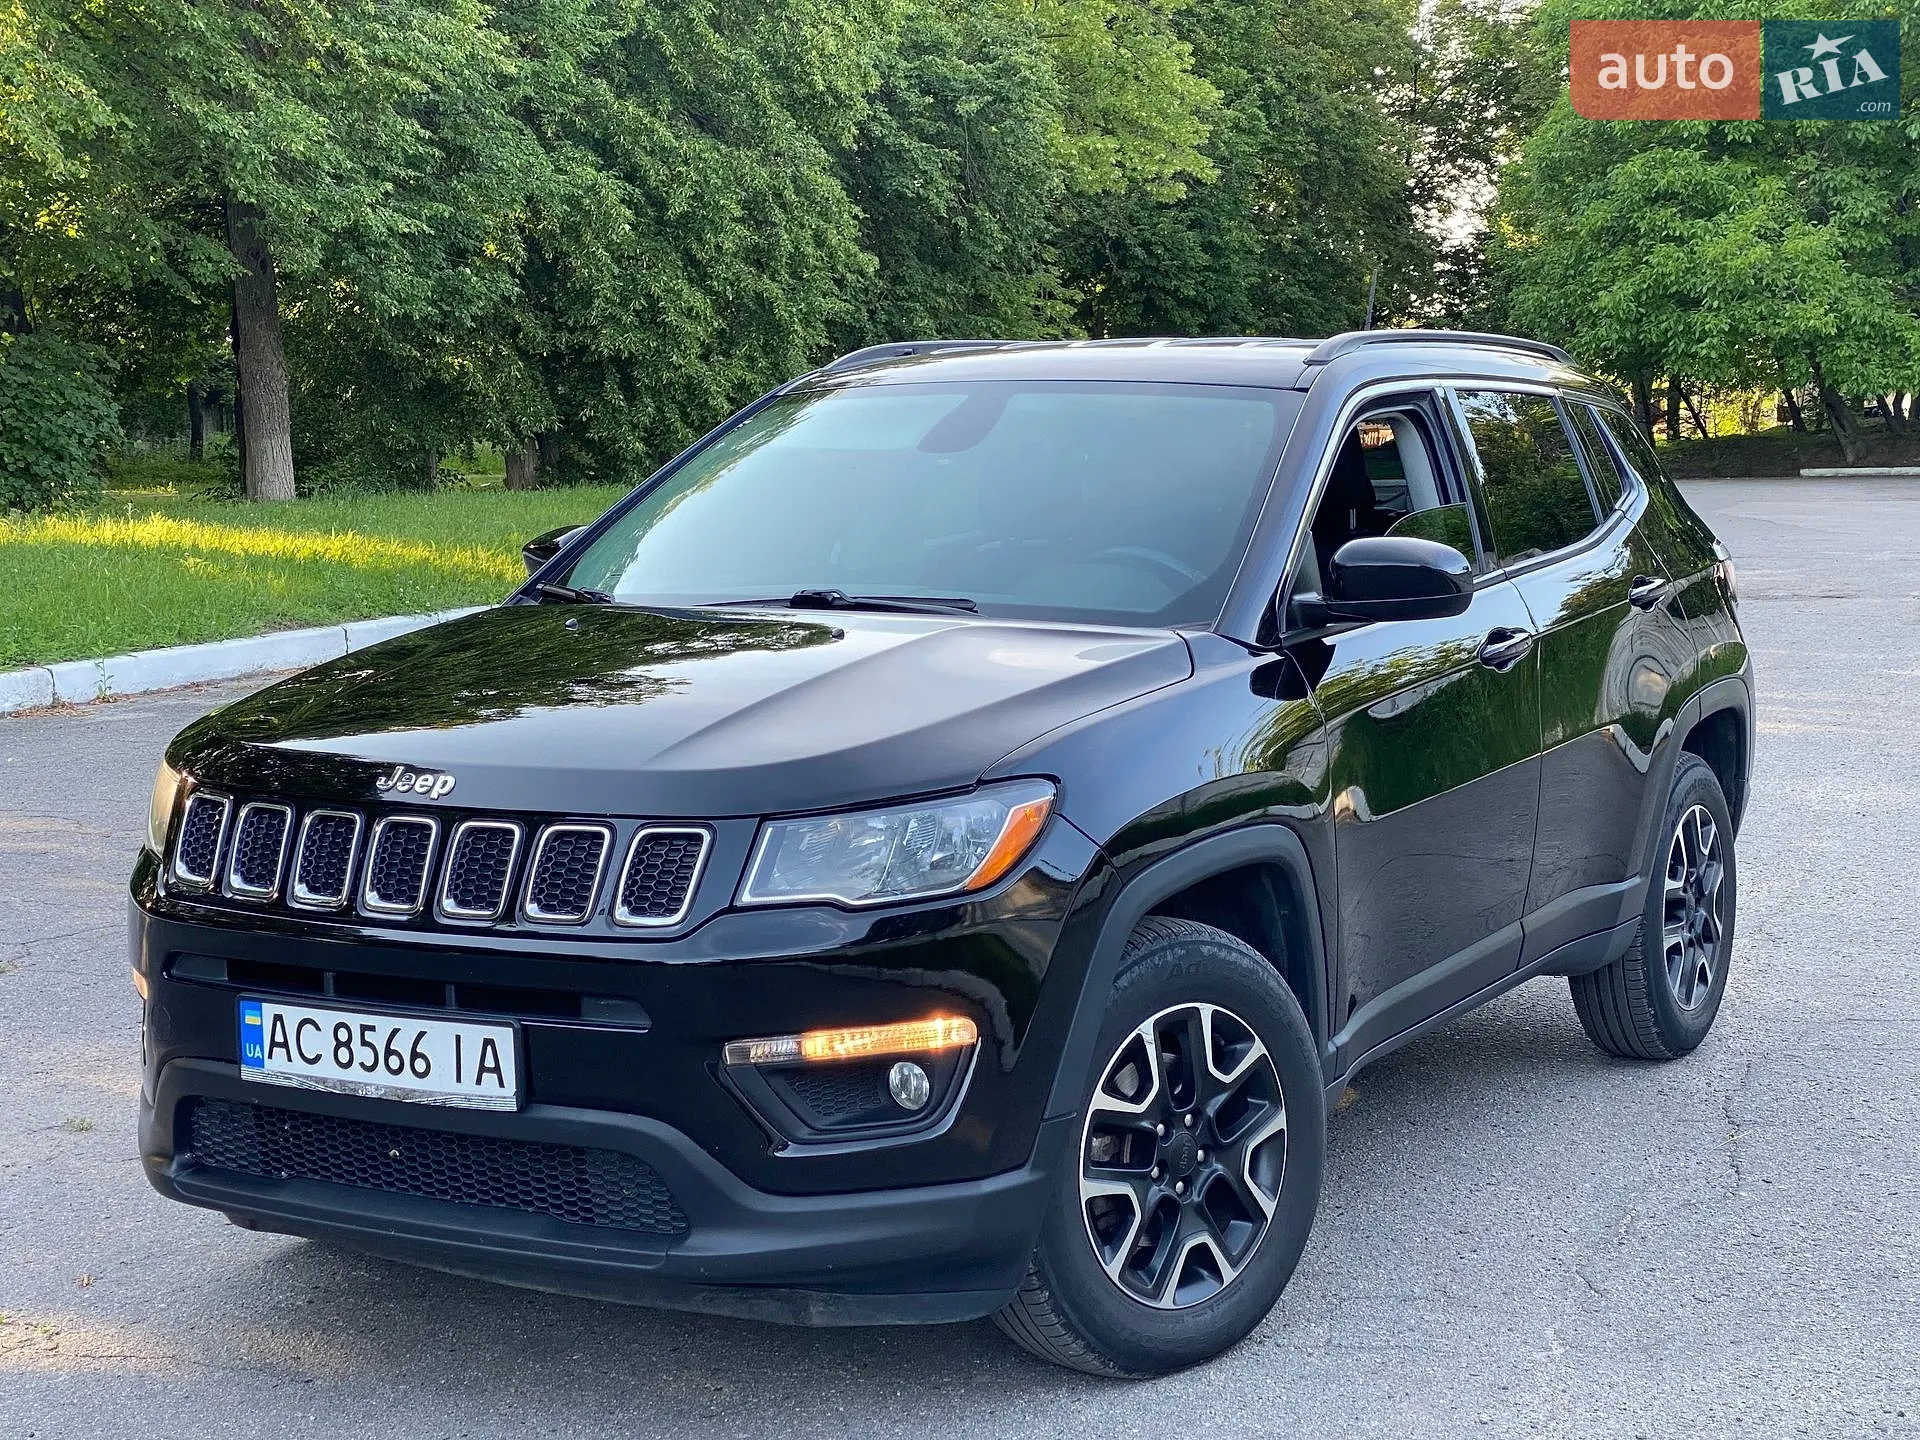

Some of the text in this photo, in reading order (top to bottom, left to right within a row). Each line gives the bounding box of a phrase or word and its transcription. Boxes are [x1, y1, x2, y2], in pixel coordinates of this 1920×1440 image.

[376, 765, 457, 801] Jeep
[246, 1043, 263, 1060] UA
[267, 1013, 506, 1089] AC 8566 IA
